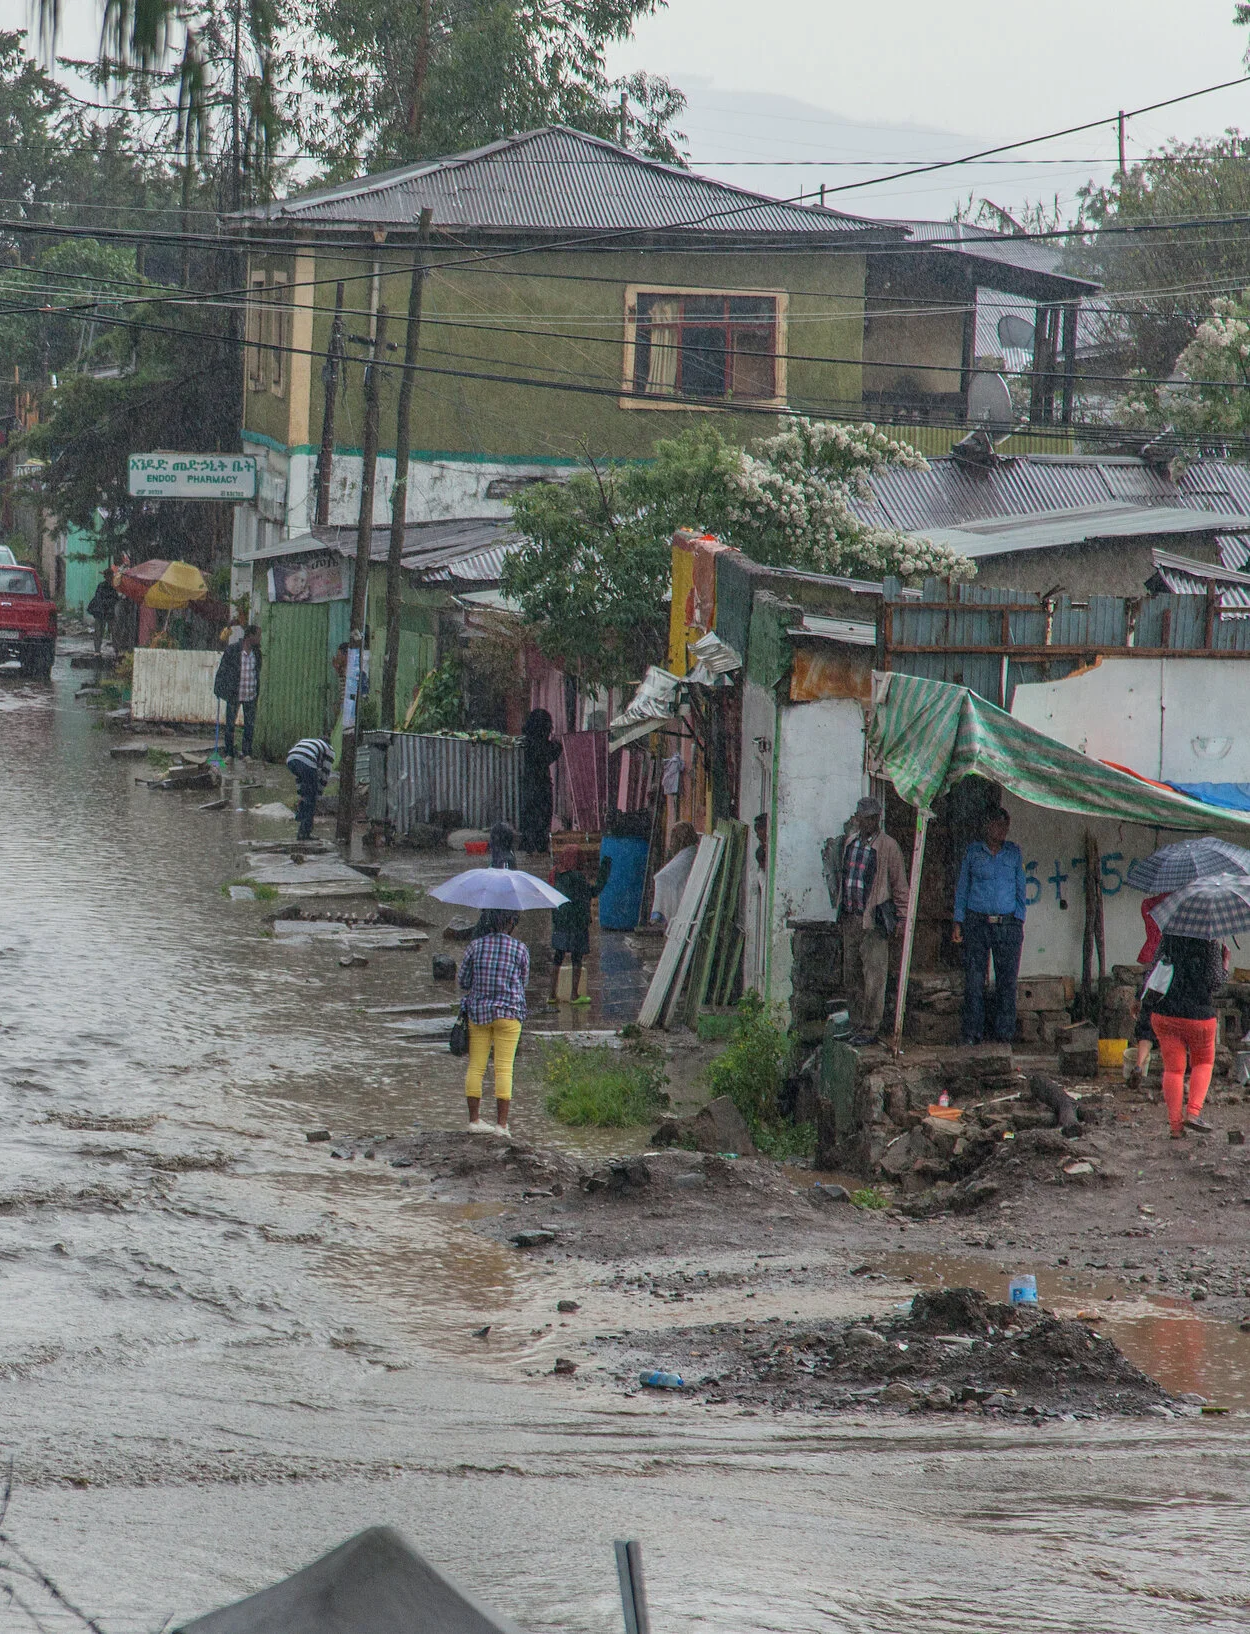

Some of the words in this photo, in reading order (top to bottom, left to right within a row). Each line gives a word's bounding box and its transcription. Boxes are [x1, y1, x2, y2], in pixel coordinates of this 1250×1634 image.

[232, 460, 255, 473] ቤት
[146, 474, 177, 483] ENDOD
[187, 475, 238, 484] PHARMACY
